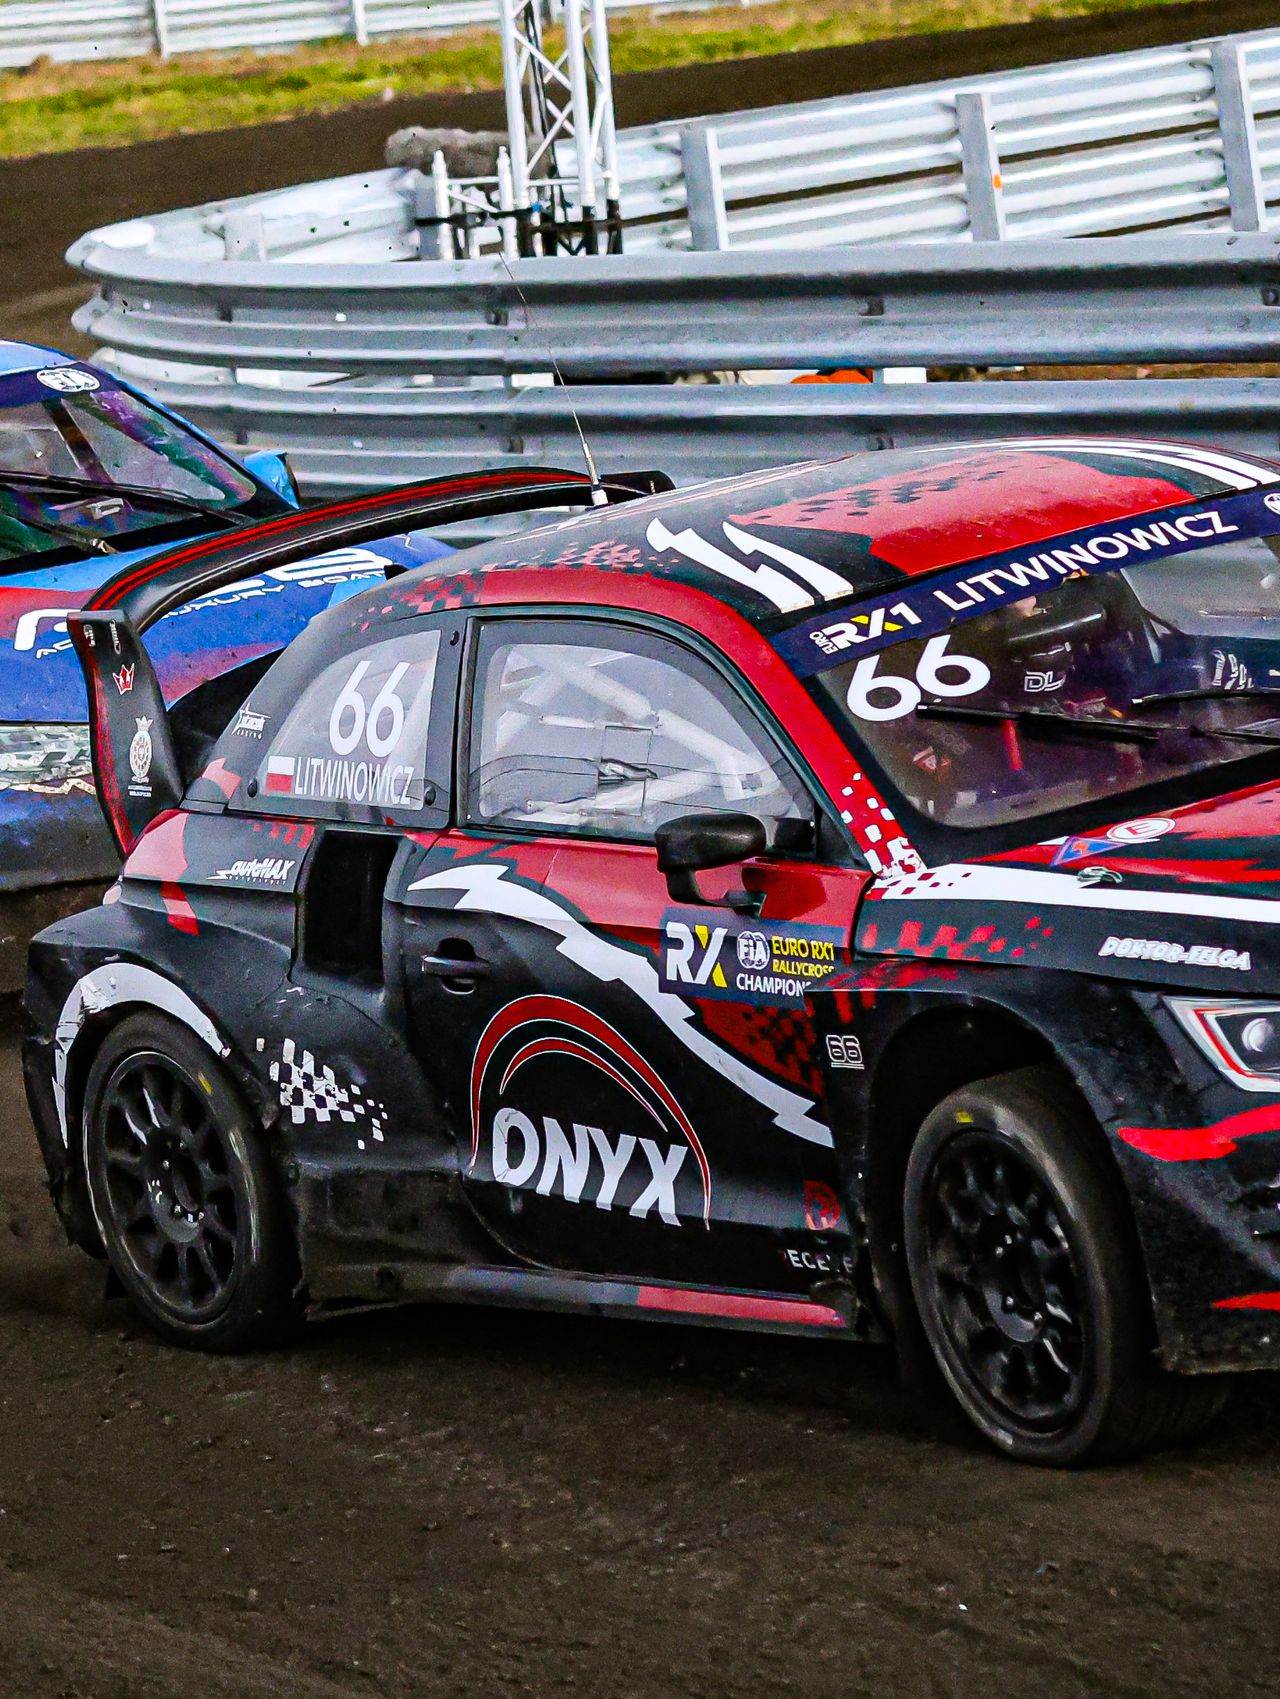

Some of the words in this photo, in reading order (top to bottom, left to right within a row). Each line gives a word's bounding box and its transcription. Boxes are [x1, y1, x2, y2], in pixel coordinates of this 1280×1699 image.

[933, 511, 1239, 611] LITWINOWICZ
[822, 602, 923, 650] RX1
[847, 634, 991, 722] 66
[330, 660, 412, 758] 66
[294, 756, 415, 805] LITWINOWICZ
[665, 921, 729, 988] RX
[771, 935, 809, 957] EURO
[811, 940, 835, 961] RX1
[1098, 936, 1252, 971] DOKTOR-FELGA
[736, 973, 812, 997] CHAMPION
[826, 1034, 863, 1064] 66
[492, 1107, 689, 1227] ONYX
